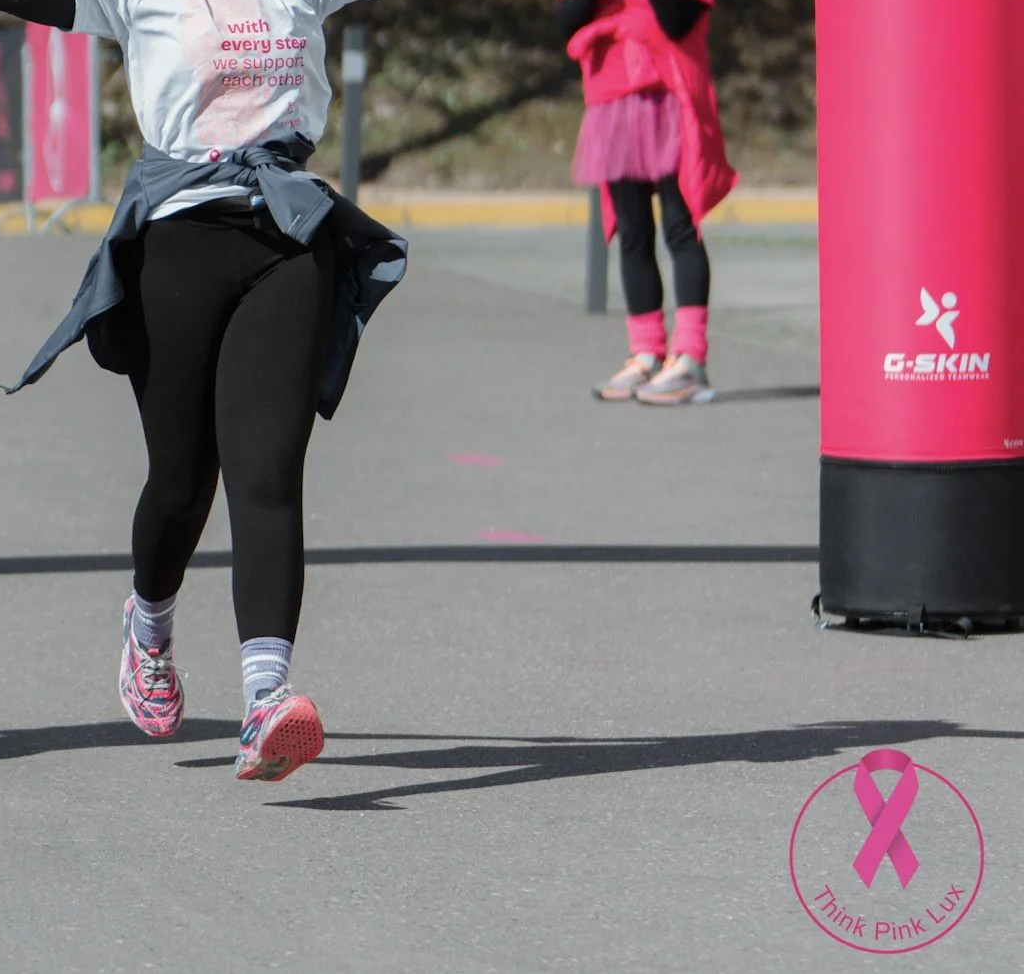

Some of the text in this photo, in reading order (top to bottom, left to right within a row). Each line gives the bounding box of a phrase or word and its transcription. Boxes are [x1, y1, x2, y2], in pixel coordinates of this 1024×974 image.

[220, 36, 306, 53] every step
[213, 56, 304, 71] we support
[221, 73, 262, 86] each
[883, 352, 990, 374] G-SKIN
[884, 373, 990, 381] PERSONALIZED TEAMWEAR
